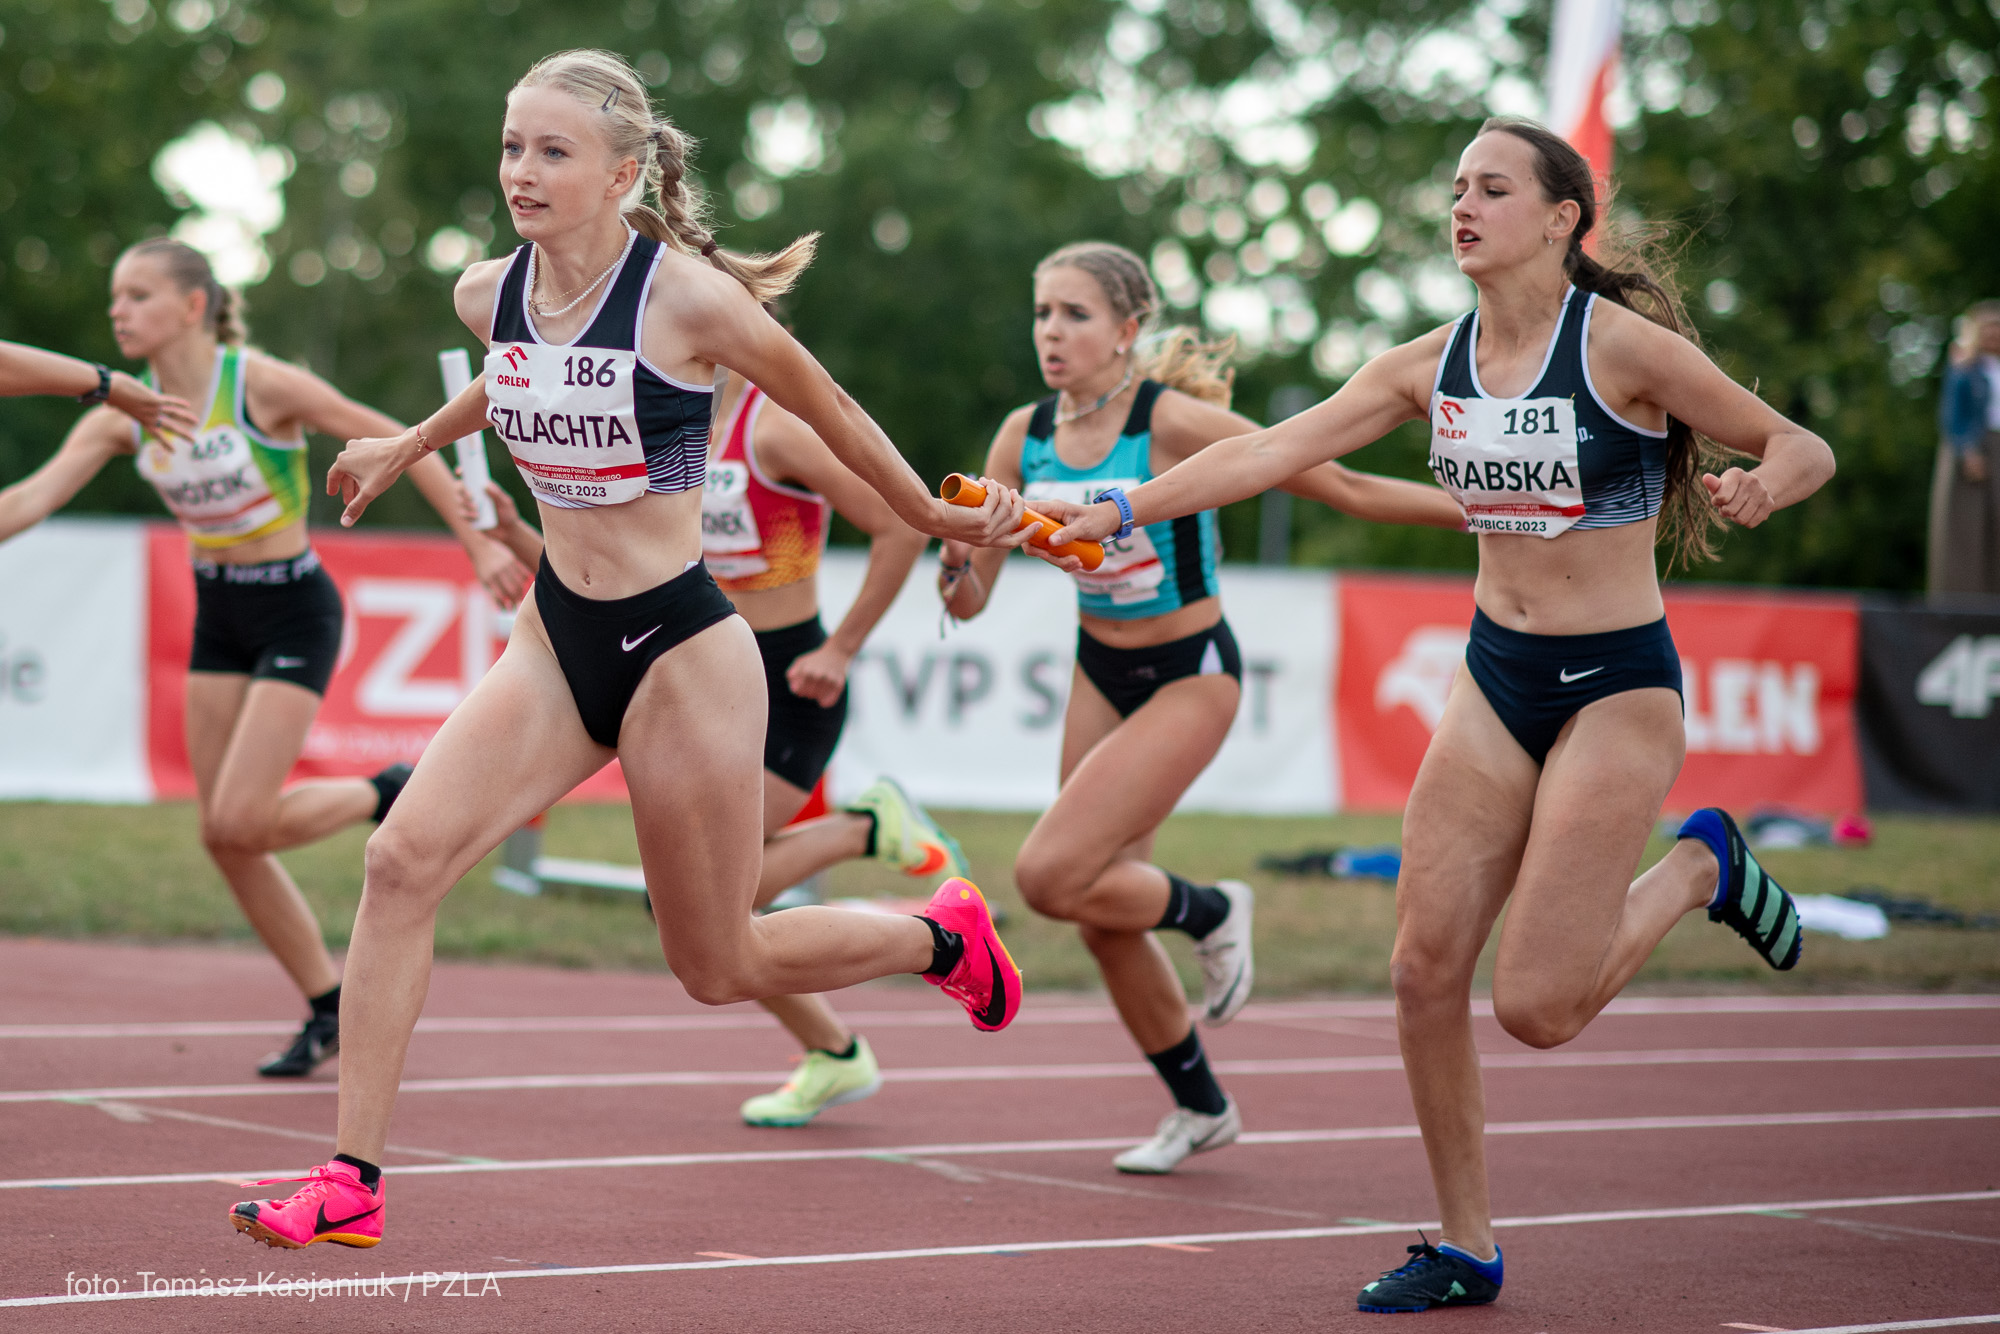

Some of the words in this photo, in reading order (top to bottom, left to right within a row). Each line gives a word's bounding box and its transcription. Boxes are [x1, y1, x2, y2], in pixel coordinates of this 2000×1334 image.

[497, 374, 530, 388] ORLEN
[563, 355, 617, 388] 186
[490, 405, 633, 448] SZLACHTA
[1503, 406, 1560, 435] 181
[190, 432, 235, 461] 465
[532, 477, 574, 496] SŁUBICE
[575, 485, 607, 498] 2023
[703, 470, 735, 492] 99
[1515, 521, 1547, 532] 2023
[224, 563, 289, 584] NIKE
[1681, 656, 1822, 756] LEN
